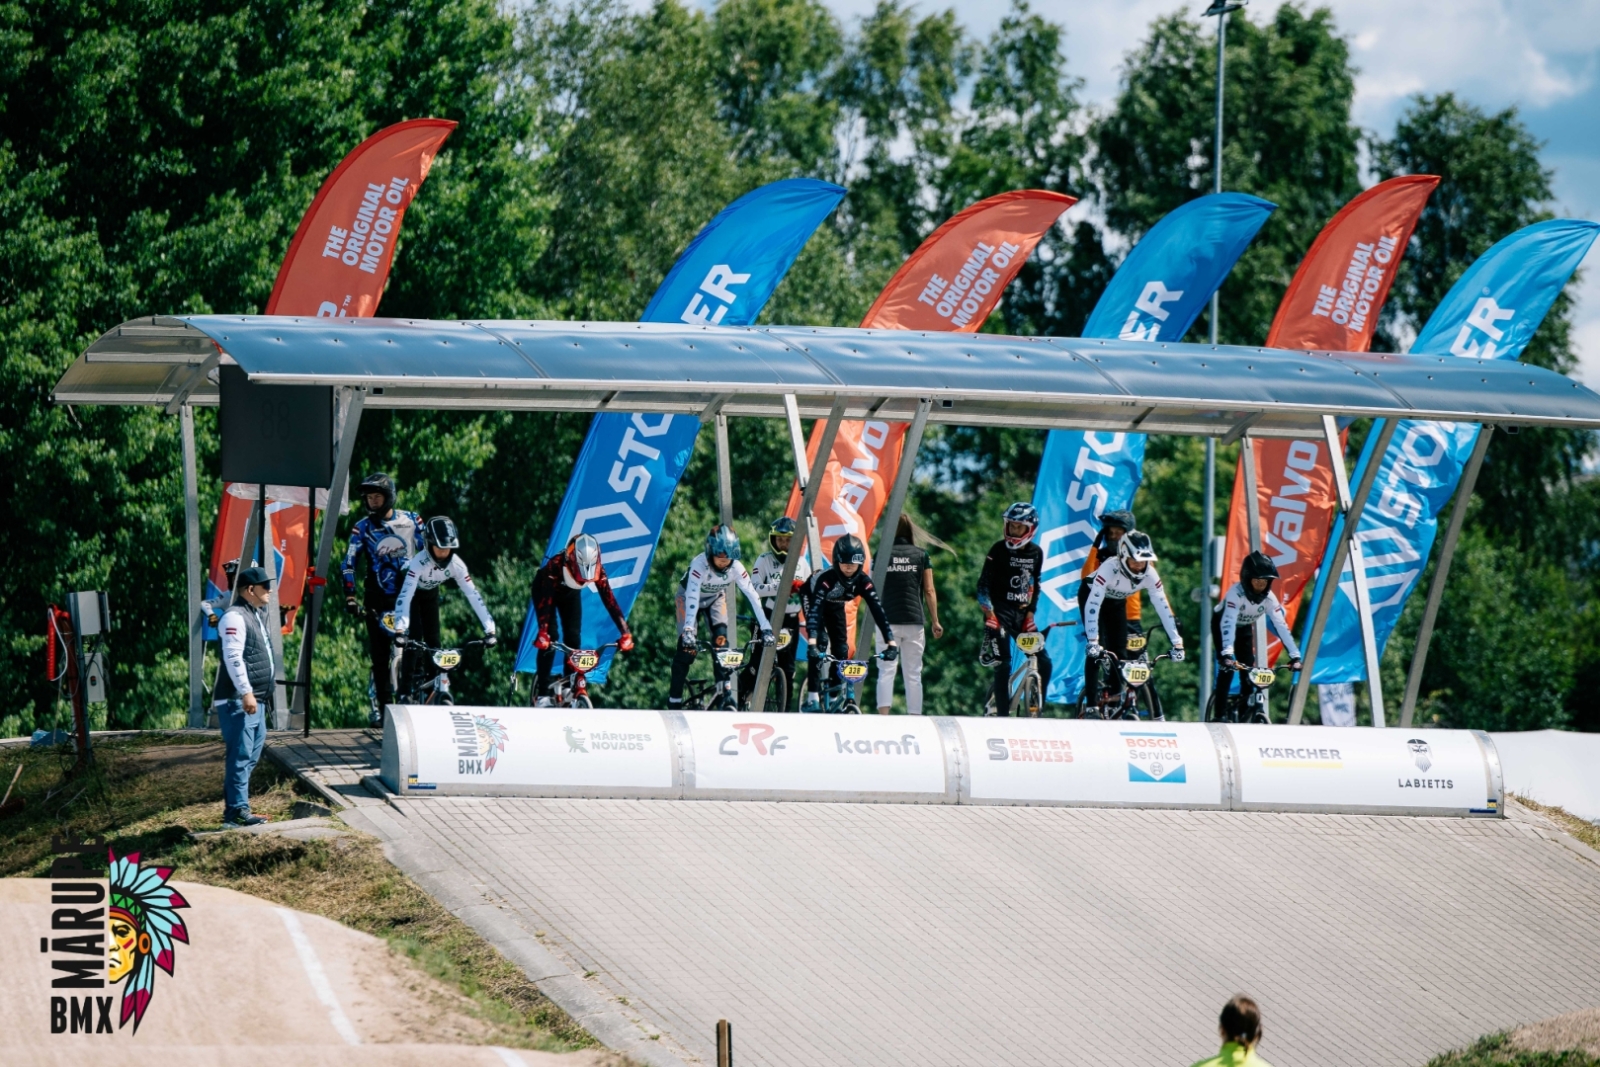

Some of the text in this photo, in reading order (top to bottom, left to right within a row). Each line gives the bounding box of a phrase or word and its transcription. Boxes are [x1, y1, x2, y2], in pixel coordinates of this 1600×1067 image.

[342, 183, 386, 266] ORIGINAL
[359, 177, 409, 274] MOTOR OIL
[322, 225, 348, 258] THE
[936, 241, 996, 317] ORIGINAL
[951, 241, 1020, 328] MOTOR OIL
[1332, 242, 1375, 324] ORIGINAL
[1348, 236, 1398, 332] MOTOR OIL
[917, 273, 948, 306] THE
[1312, 284, 1337, 317] THE
[893, 556, 911, 564] BMX
[1007, 592, 1028, 602] BMX
[443, 656, 457, 665] 145
[581, 657, 595, 666] 413
[1131, 670, 1147, 680] 108
[1259, 675, 1272, 683] 100
[590, 731, 652, 742] MĀRUPES
[1126, 738, 1178, 748] BOSCH
[591, 741, 645, 751] NOVADS
[834, 732, 921, 755] kamfi
[1129, 749, 1181, 760] Service
[1258, 747, 1342, 760] KÄRCHER
[458, 759, 483, 775] BMX
[1398, 778, 1454, 789] LABIETIS
